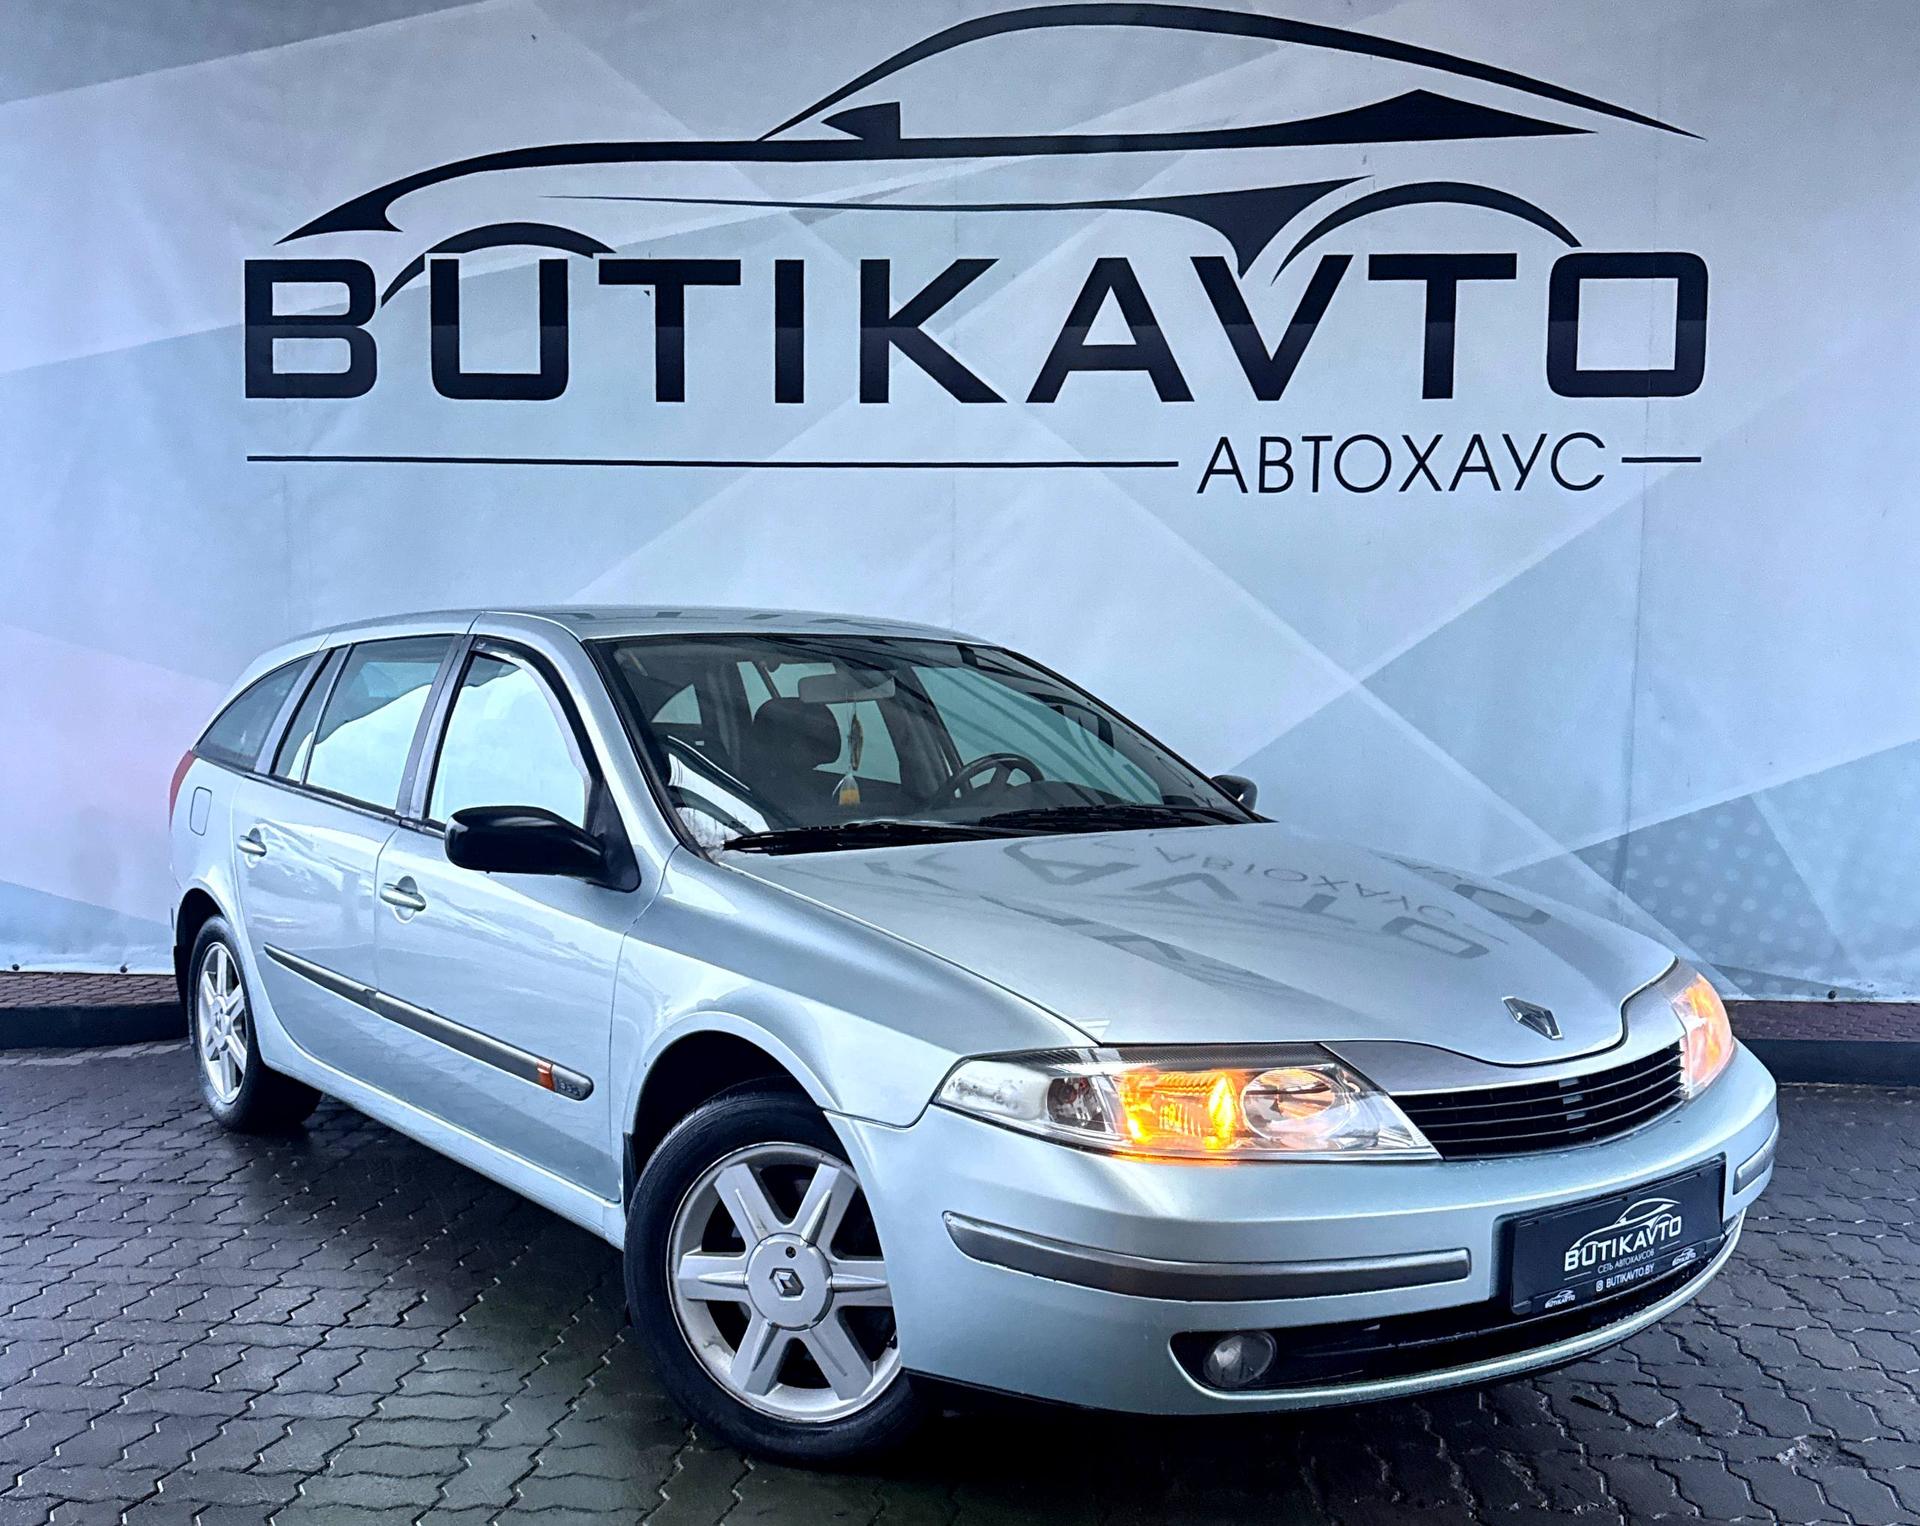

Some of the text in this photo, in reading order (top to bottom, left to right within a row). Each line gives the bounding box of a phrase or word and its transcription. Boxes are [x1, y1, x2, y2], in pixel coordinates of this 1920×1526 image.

[244, 252, 1709, 404] BUTIKAVTO
[1197, 431, 1607, 495] АВТОХАУС
[1563, 1215, 1683, 1273] BUTIKAVTO
[1614, 1249, 1655, 1269] АВТОХАУСОВ
[1606, 1263, 1655, 1289] BUTIKAVTO.BY
